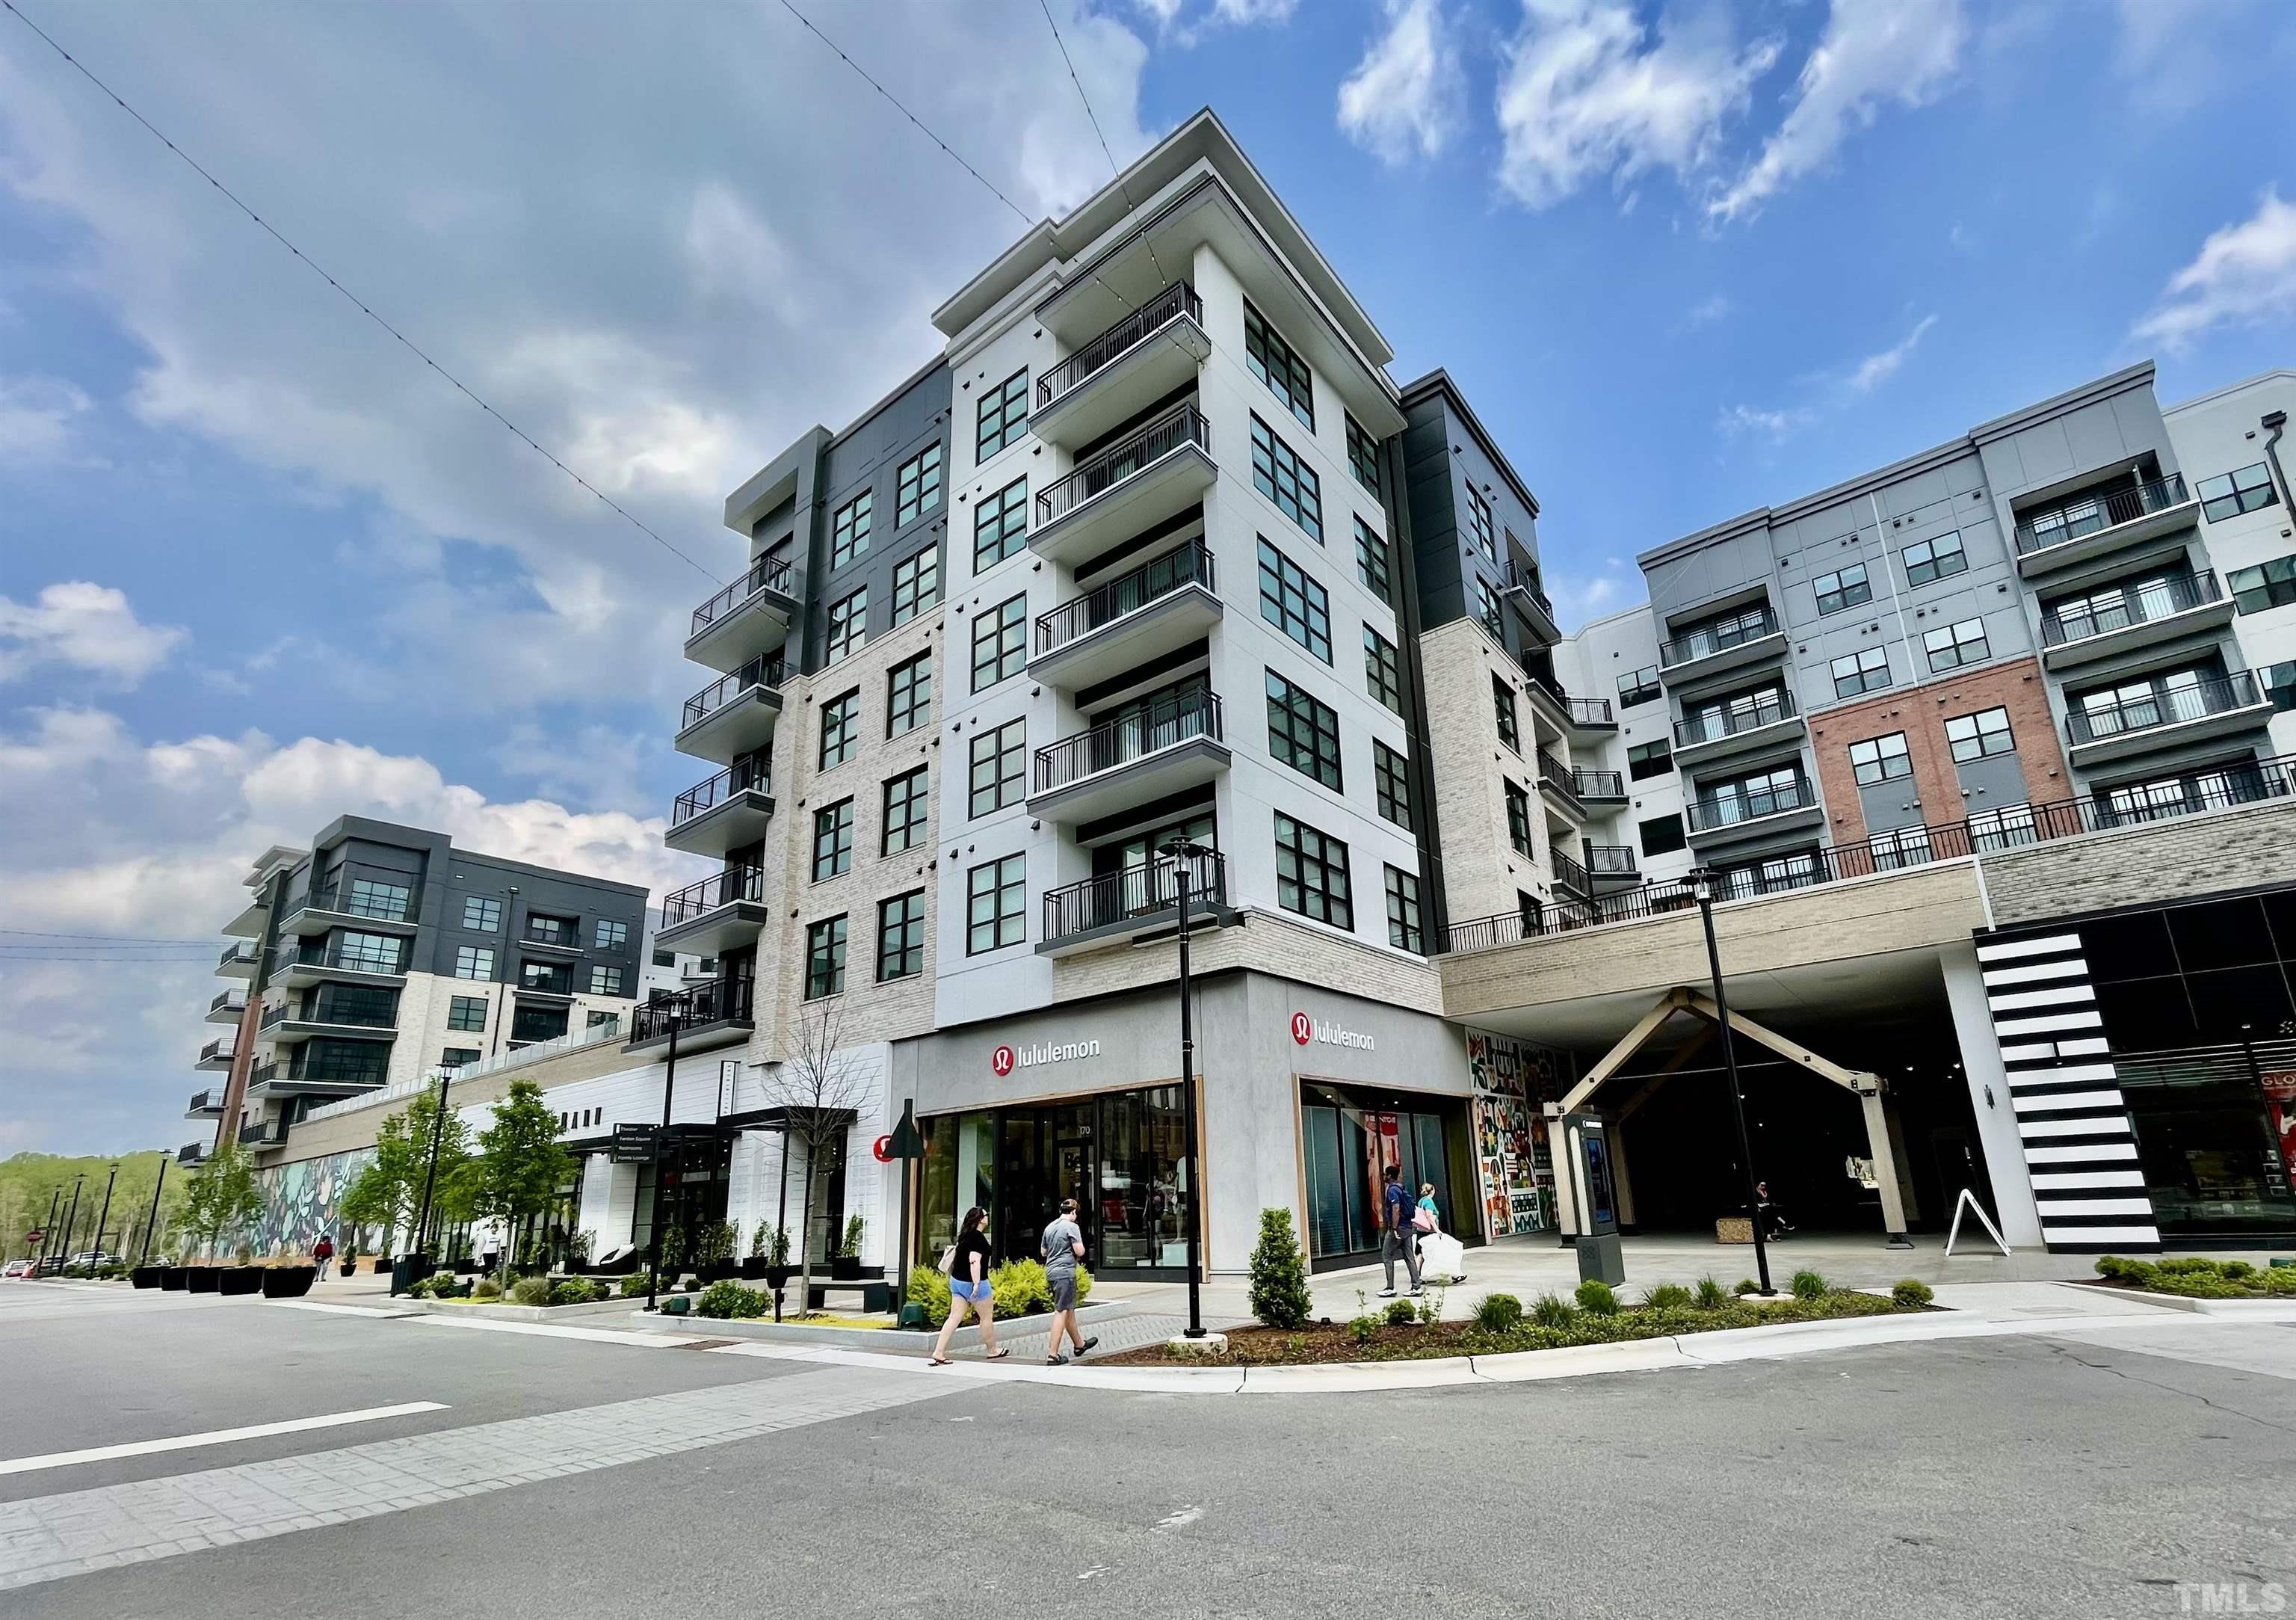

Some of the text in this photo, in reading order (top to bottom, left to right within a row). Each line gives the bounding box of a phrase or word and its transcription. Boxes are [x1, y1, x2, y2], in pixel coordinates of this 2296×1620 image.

[1314, 1019, 1374, 1051] lululemon
[1018, 1039, 1100, 1068] lululemon
[2261, 1074, 2296, 1085] GLO
[1078, 1125, 1090, 1135] 170
